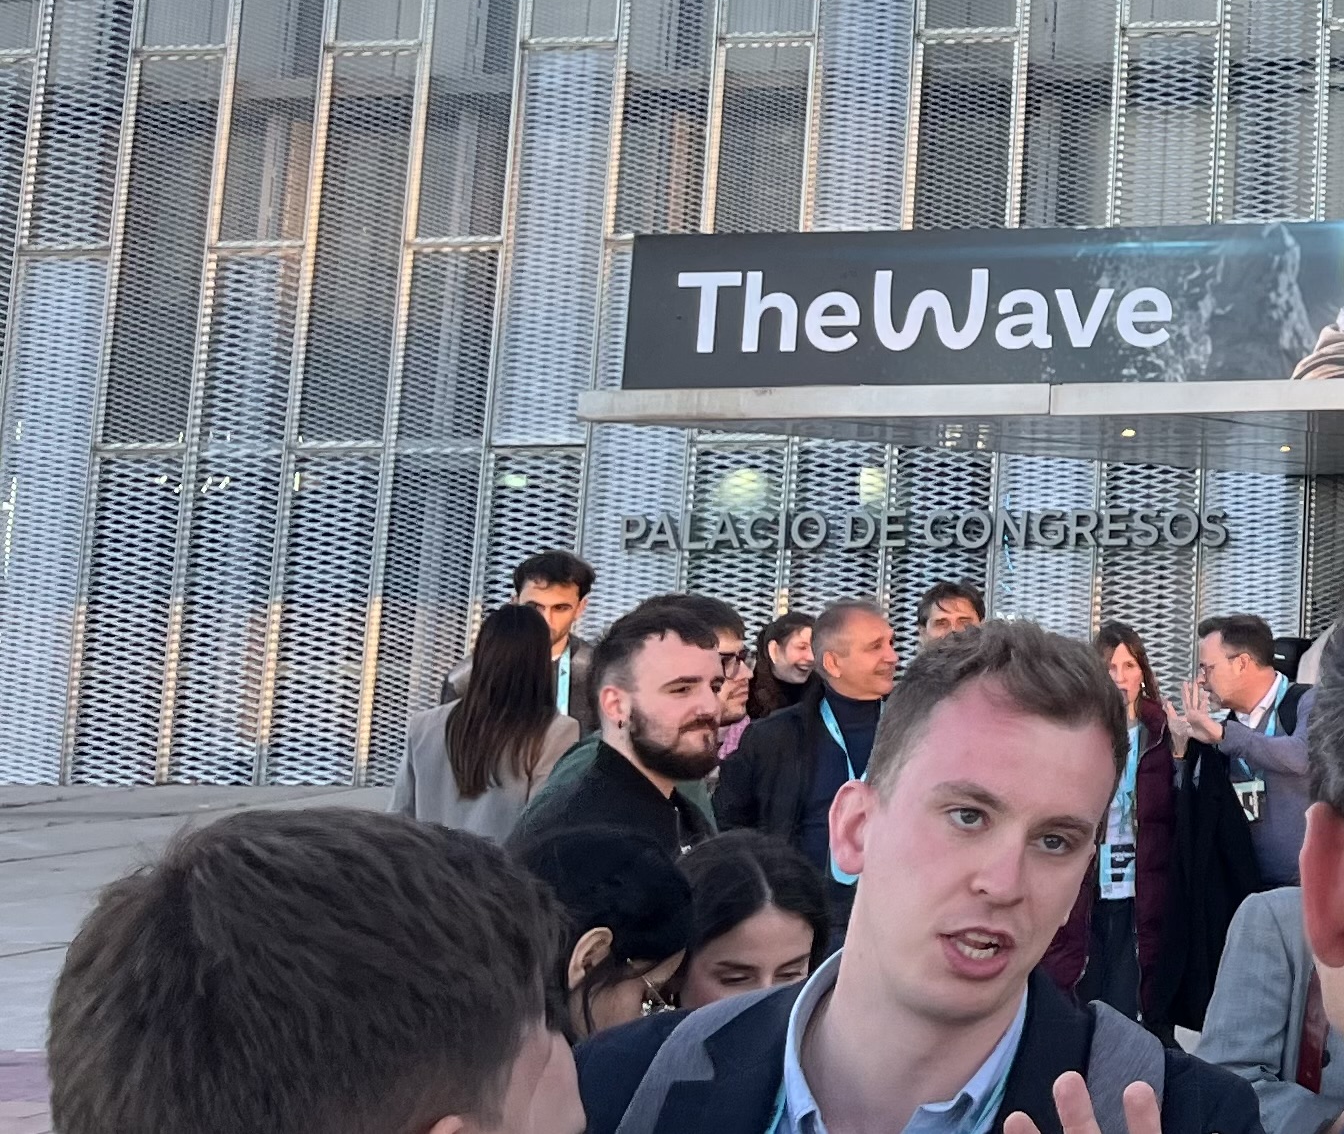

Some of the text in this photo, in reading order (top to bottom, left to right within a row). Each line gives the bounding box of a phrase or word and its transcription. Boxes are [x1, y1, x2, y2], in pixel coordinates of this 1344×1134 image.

[677, 268, 1173, 354] TheWave
[620, 508, 1227, 550] PALACIO DE CONGRESOS
